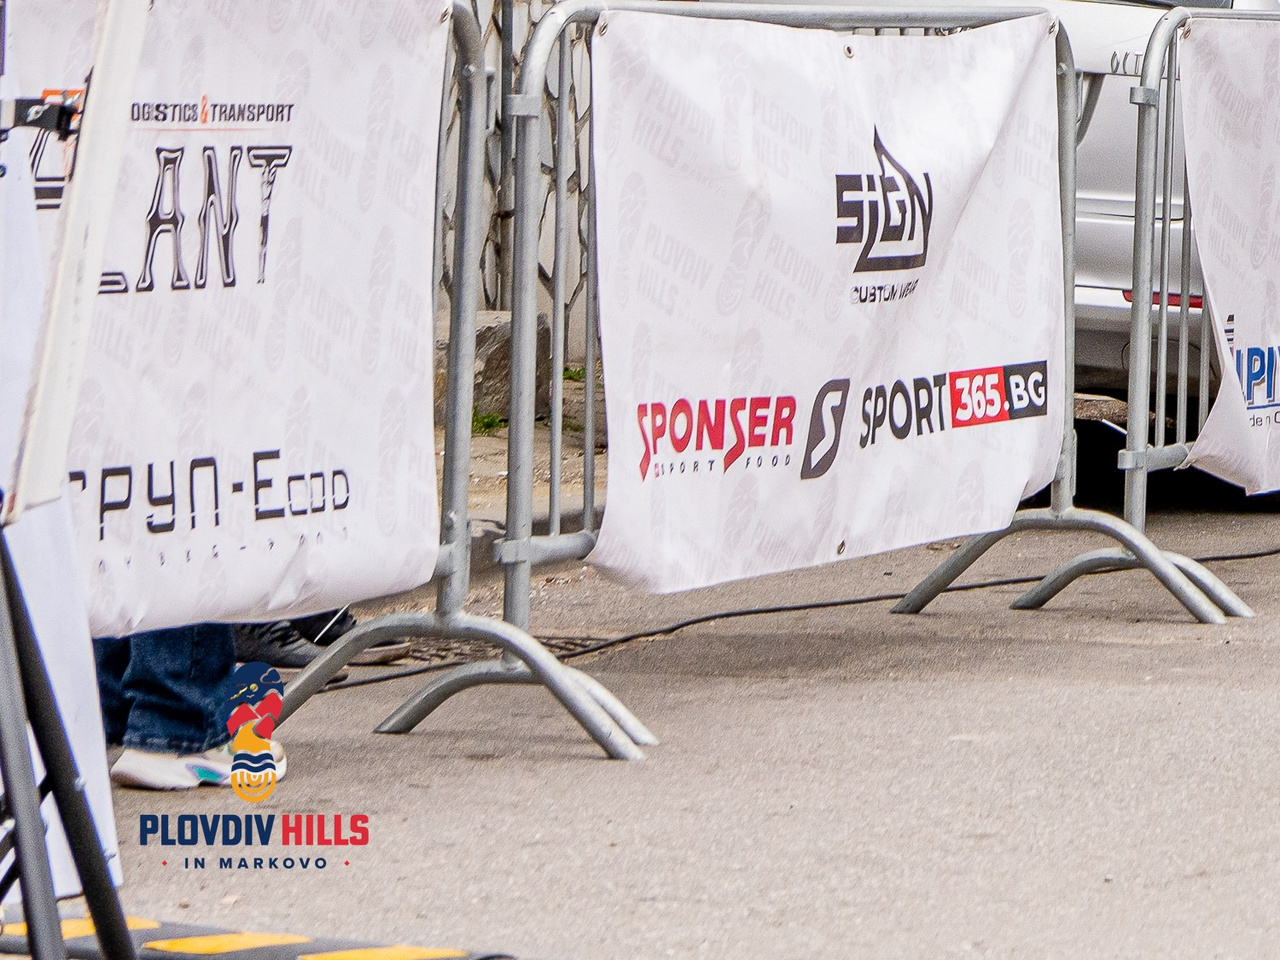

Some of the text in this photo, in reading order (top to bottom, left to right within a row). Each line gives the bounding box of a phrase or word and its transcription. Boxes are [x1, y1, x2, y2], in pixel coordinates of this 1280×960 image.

[210, 103, 294, 122] TRANSPORT
[637, 394, 797, 482] SPONSER
[745, 455, 792, 470] FOOD
